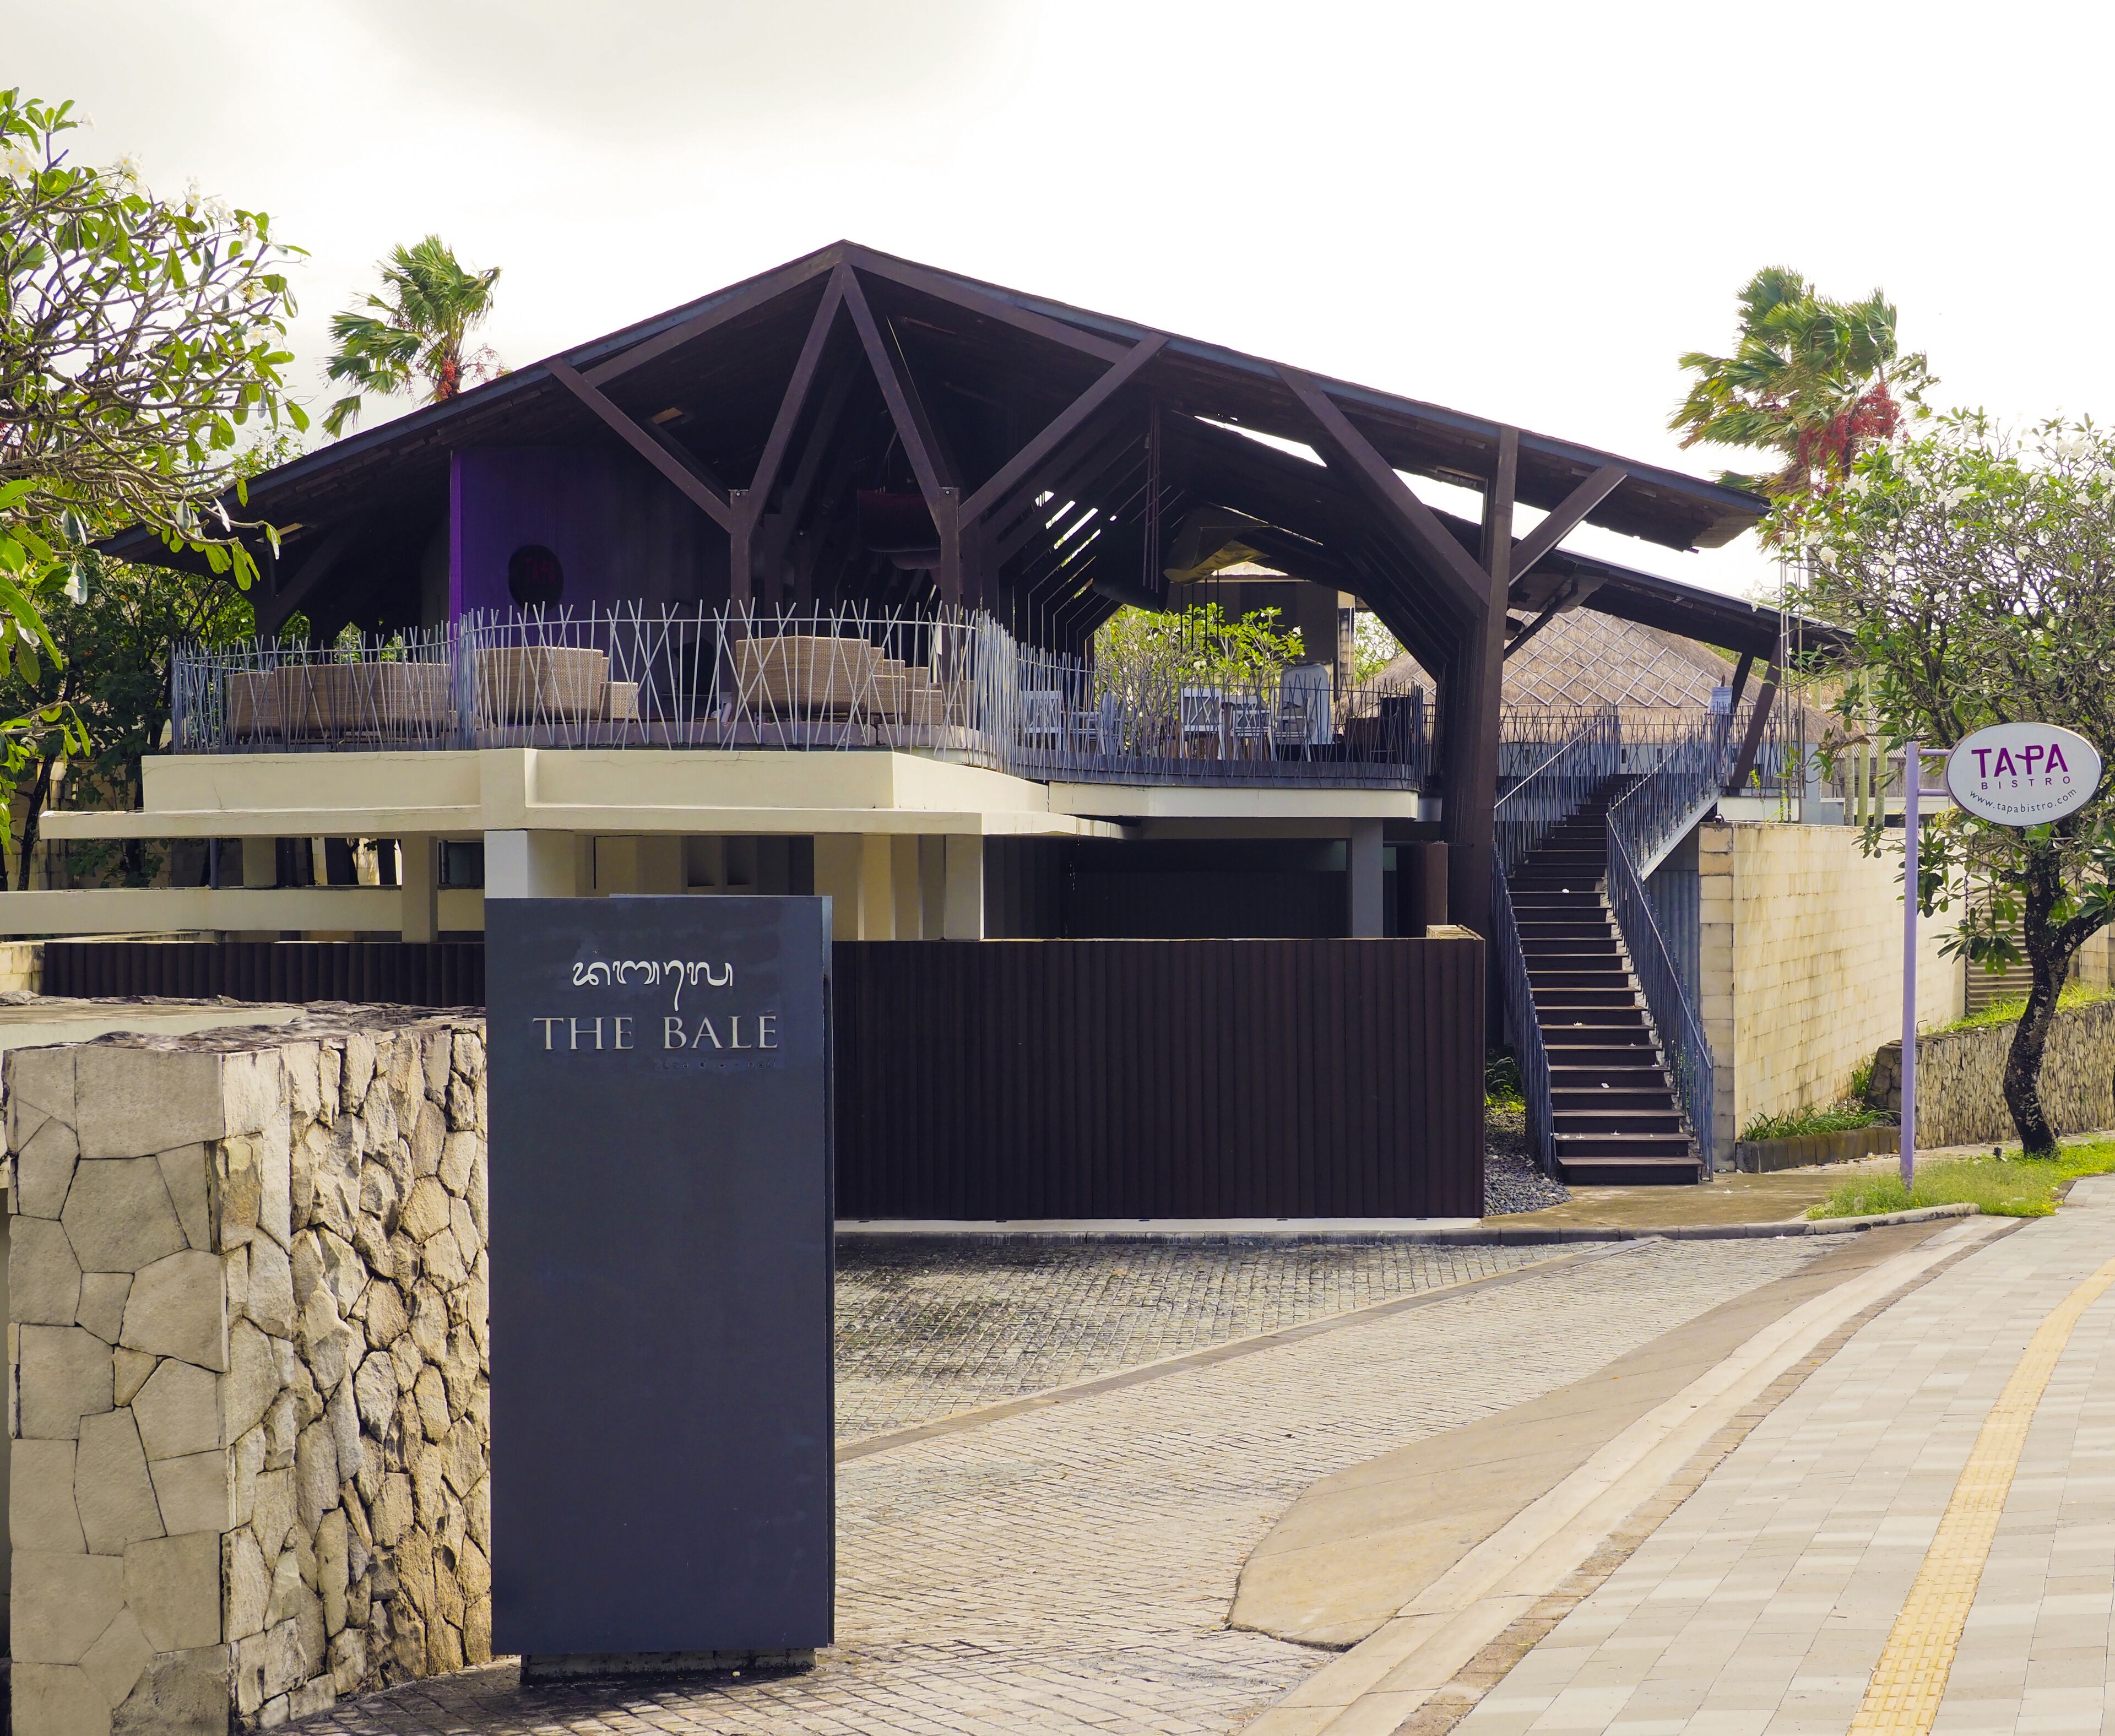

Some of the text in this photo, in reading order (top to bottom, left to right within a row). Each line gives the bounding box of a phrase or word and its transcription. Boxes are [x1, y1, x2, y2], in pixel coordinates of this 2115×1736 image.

[1971, 744, 2069, 778] TAPA
[1981, 776, 2071, 790] BISTRO
[1970, 789, 2077, 814] www.tapabistro.com
[533, 1017, 633, 1050] THE
